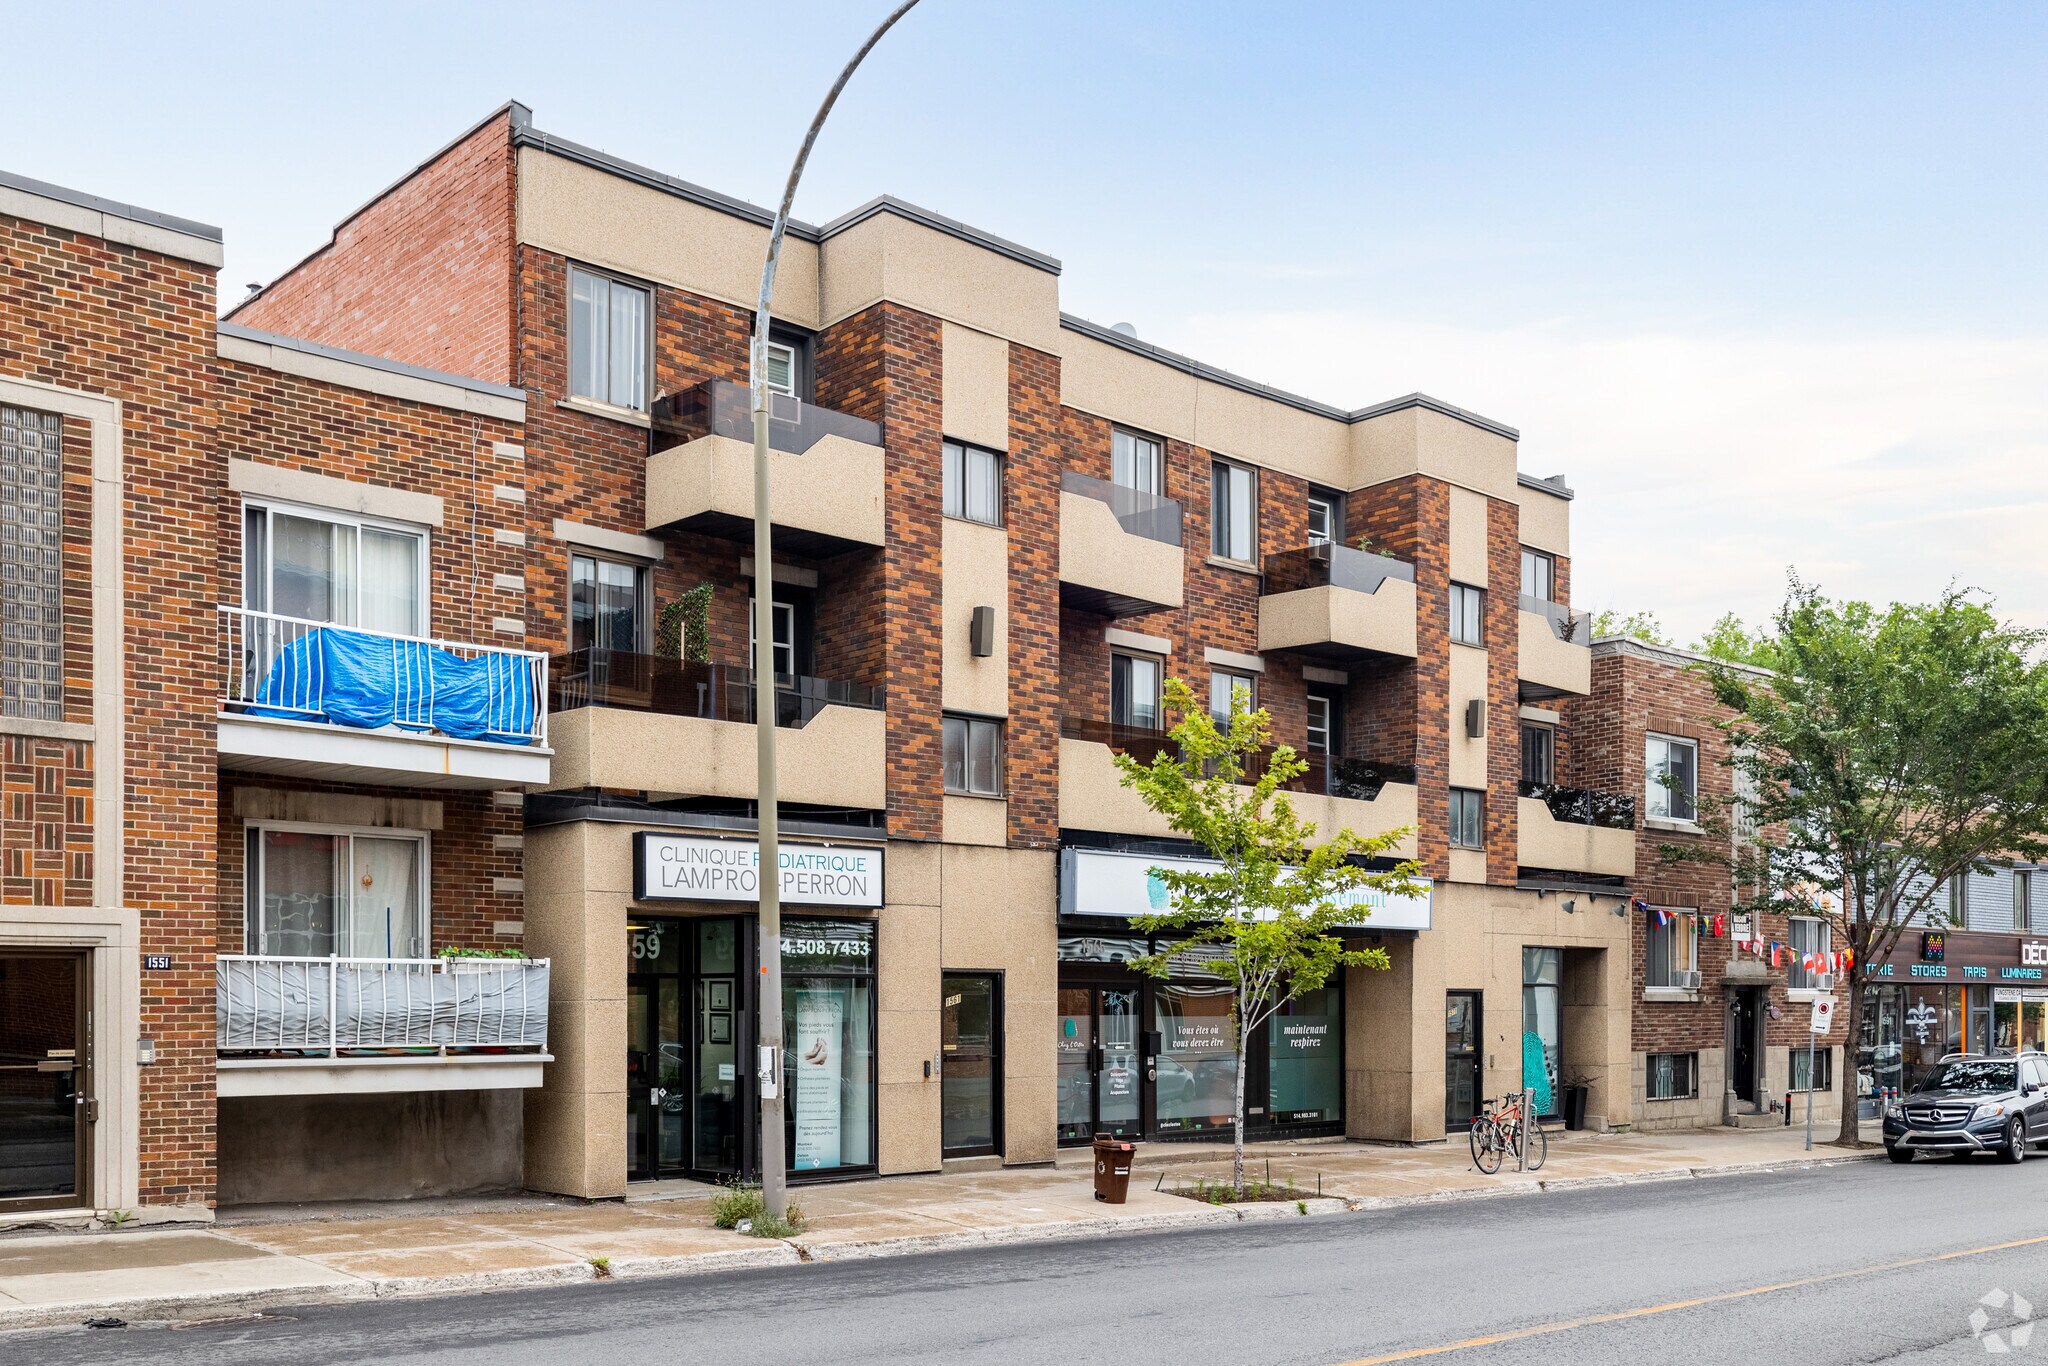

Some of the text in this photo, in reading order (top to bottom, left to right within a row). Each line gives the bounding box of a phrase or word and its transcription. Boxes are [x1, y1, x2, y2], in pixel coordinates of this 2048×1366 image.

[660, 845, 867, 873] CLINIQUE PDIATRIQUE
[661, 866, 867, 897] LAMPRO-PERRON
[2022, 941, 2048, 965] DÉC
[148, 957, 169, 968] 1551
[1911, 964, 1947, 977] STORES
[1963, 966, 1987, 978] TAPIS
[1178, 1024, 1219, 1035] Vous êtes où
[1283, 1024, 1328, 1035] maintenant
[1172, 1036, 1225, 1048] vous devez être
[1290, 1037, 1321, 1049] respirez
